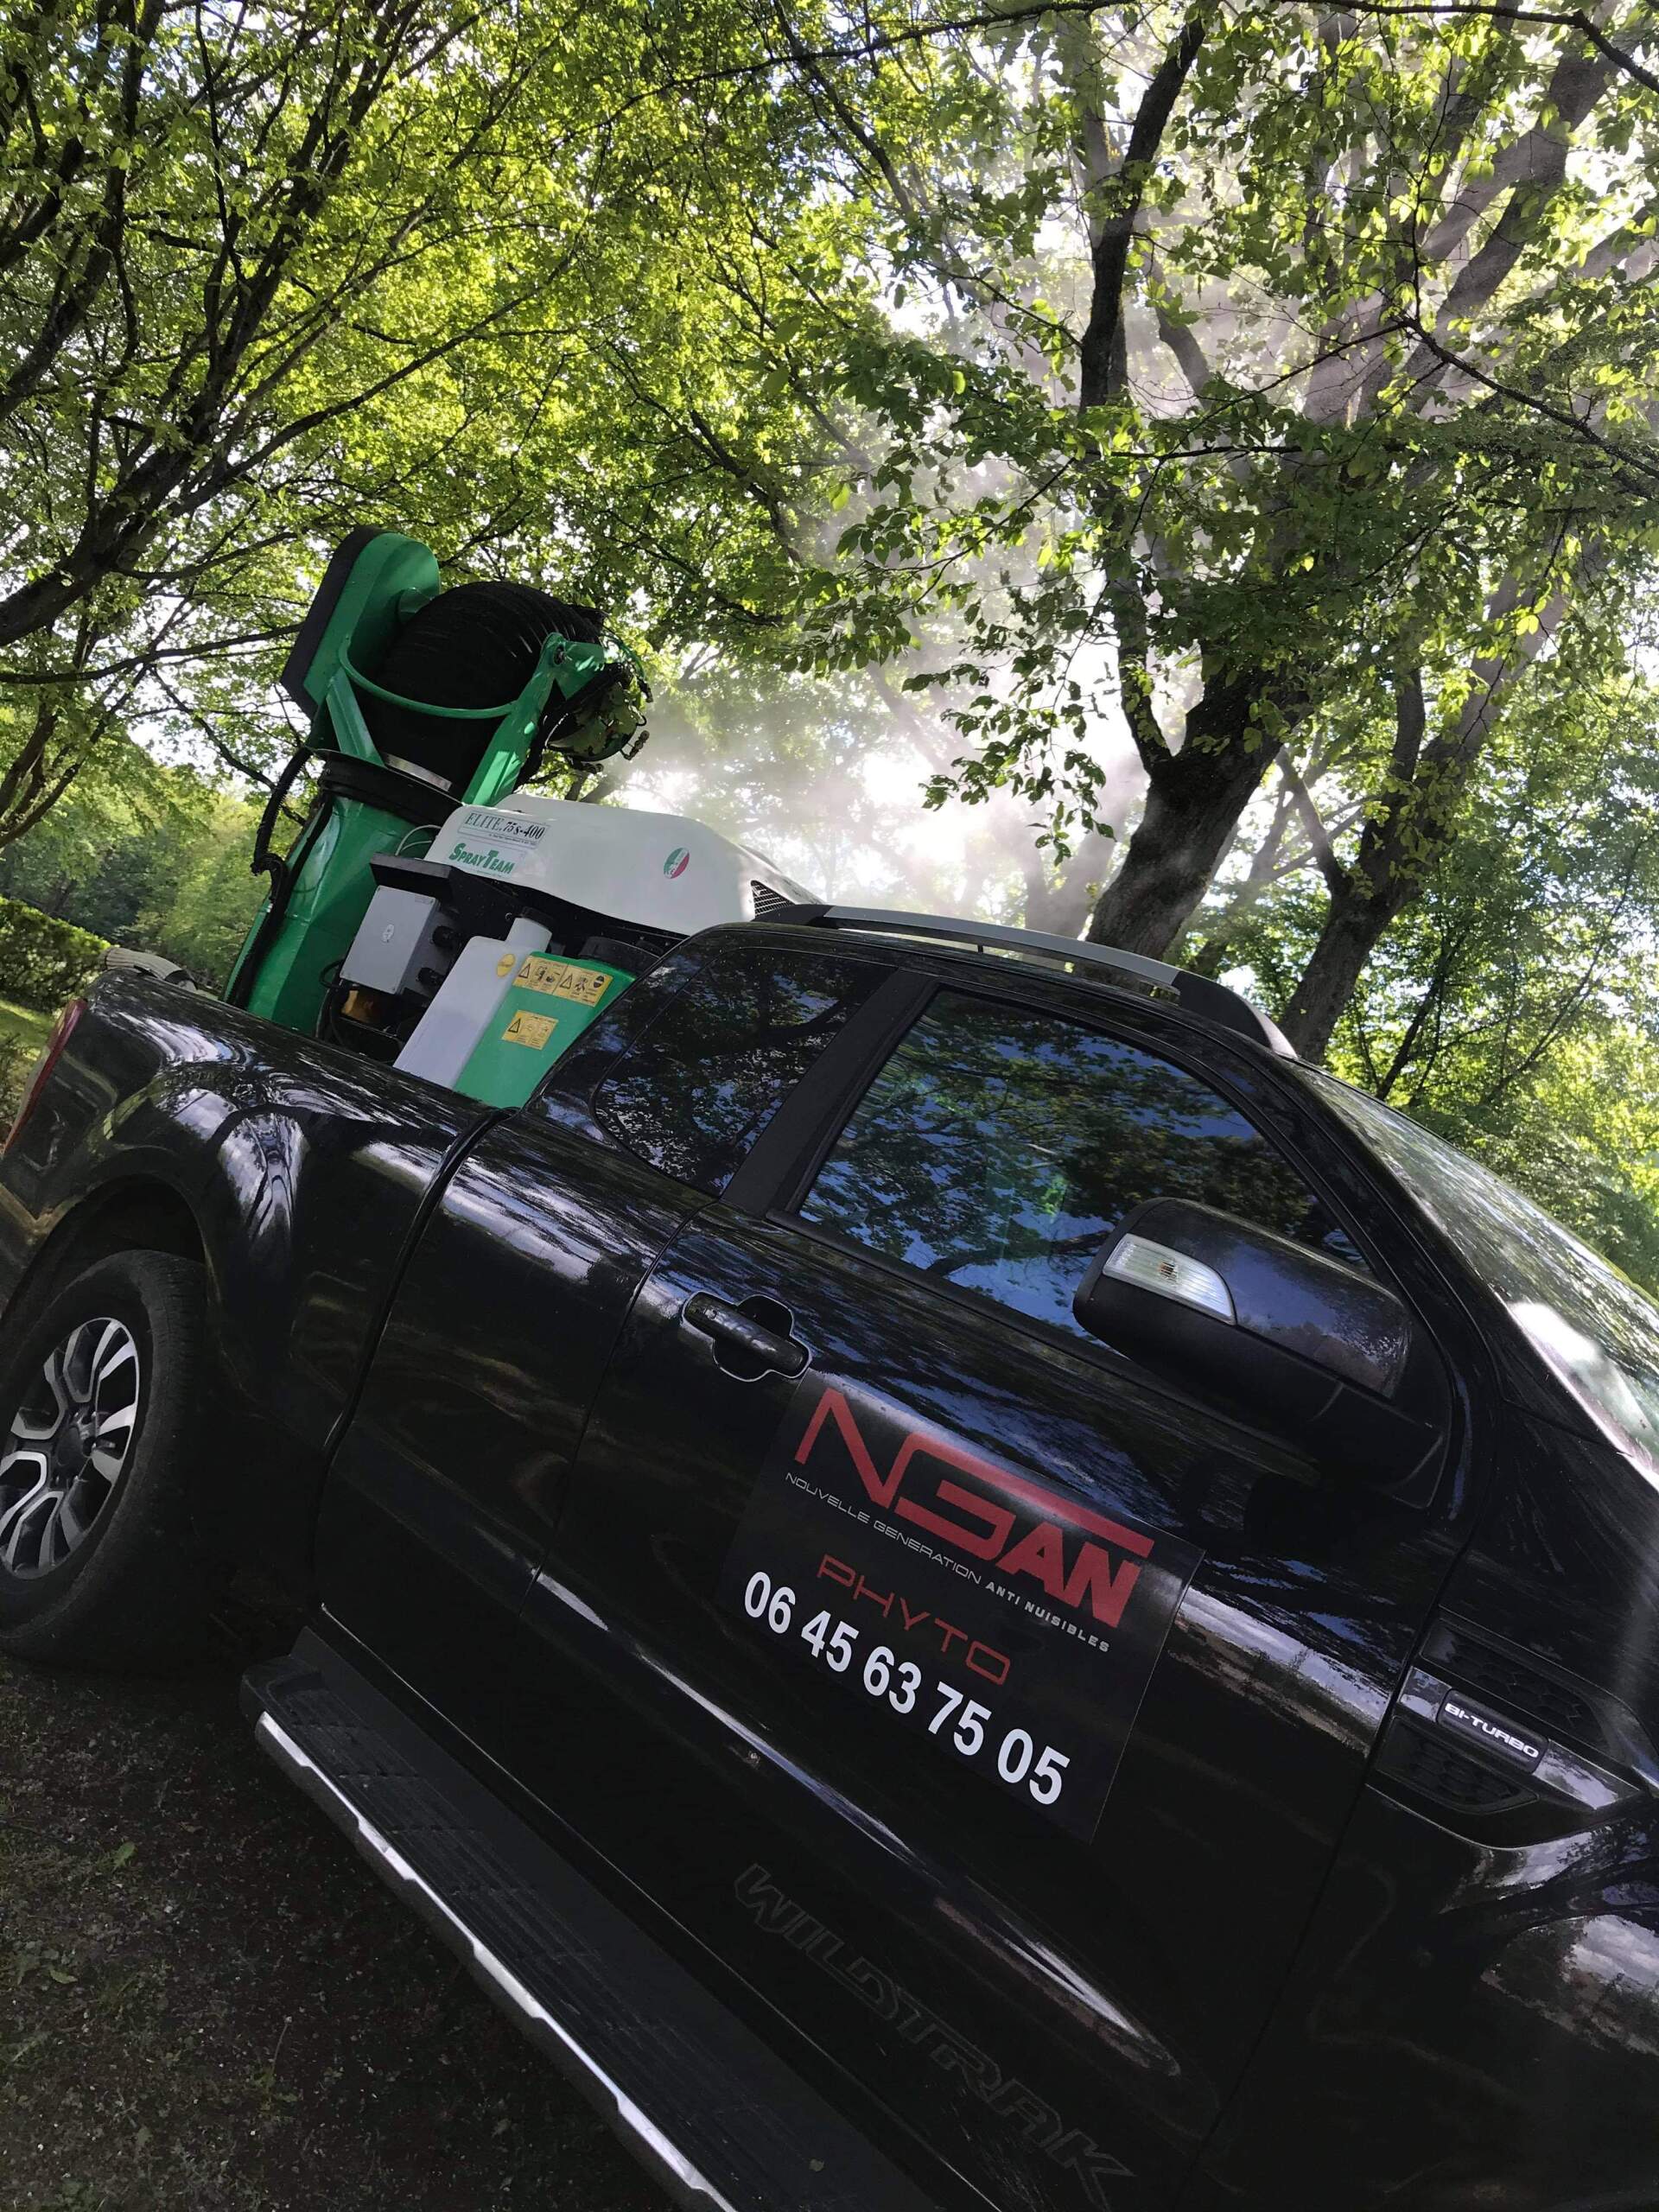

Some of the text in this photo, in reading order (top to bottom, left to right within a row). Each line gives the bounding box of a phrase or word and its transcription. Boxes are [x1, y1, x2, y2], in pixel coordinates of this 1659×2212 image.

[785, 1471, 1110, 1652] NOUVELLE GENERATION ANTI NUISIBLES
[817, 1554, 1011, 1686] PHYTO
[744, 1572, 1071, 1805] 06 45 63 75 05
